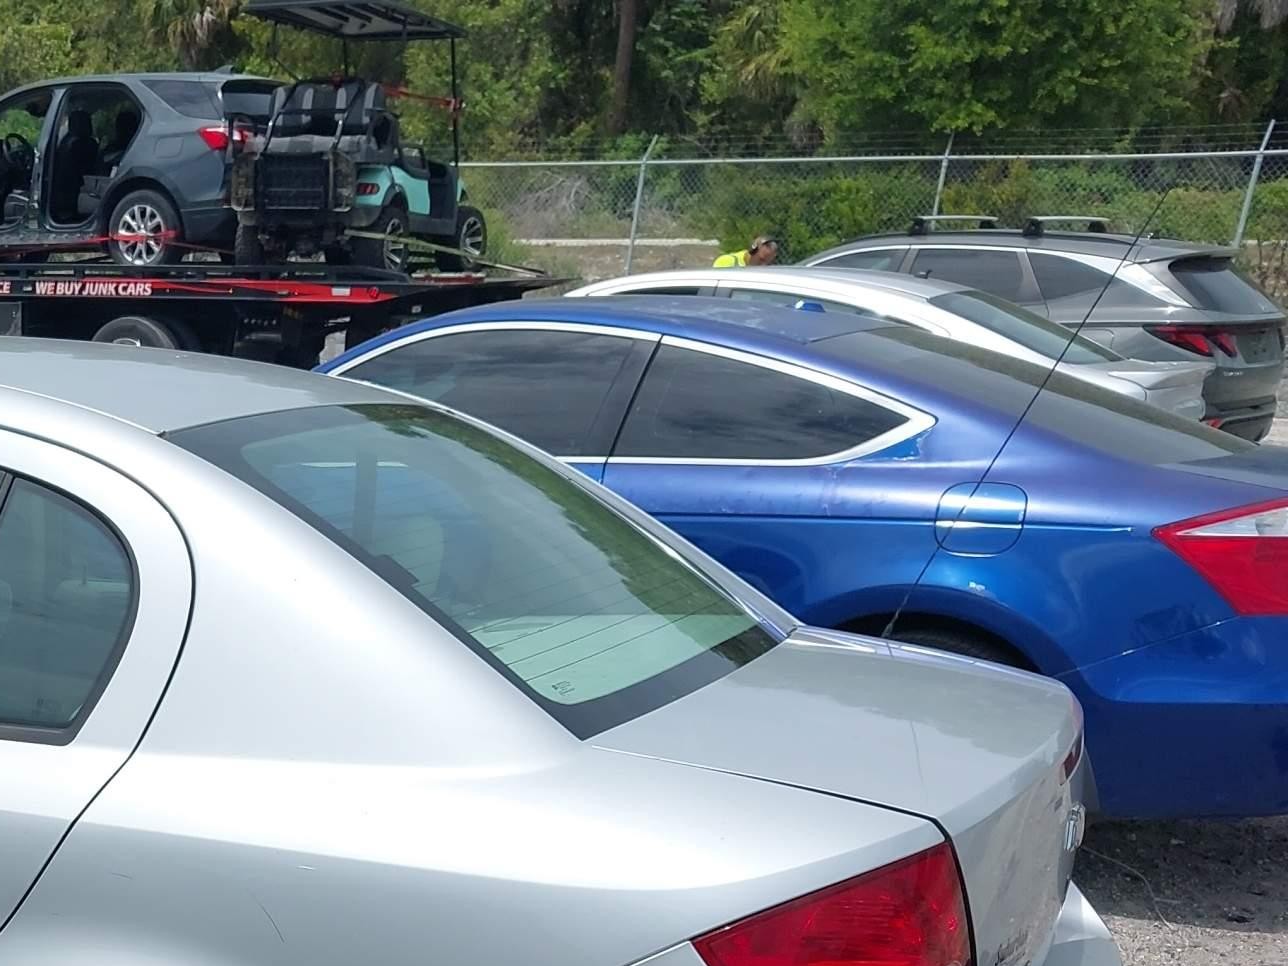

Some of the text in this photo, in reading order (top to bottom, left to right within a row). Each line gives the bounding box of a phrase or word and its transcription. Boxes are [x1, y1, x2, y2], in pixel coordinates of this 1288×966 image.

[35, 281, 152, 295] WE BUY JUNK CARS
